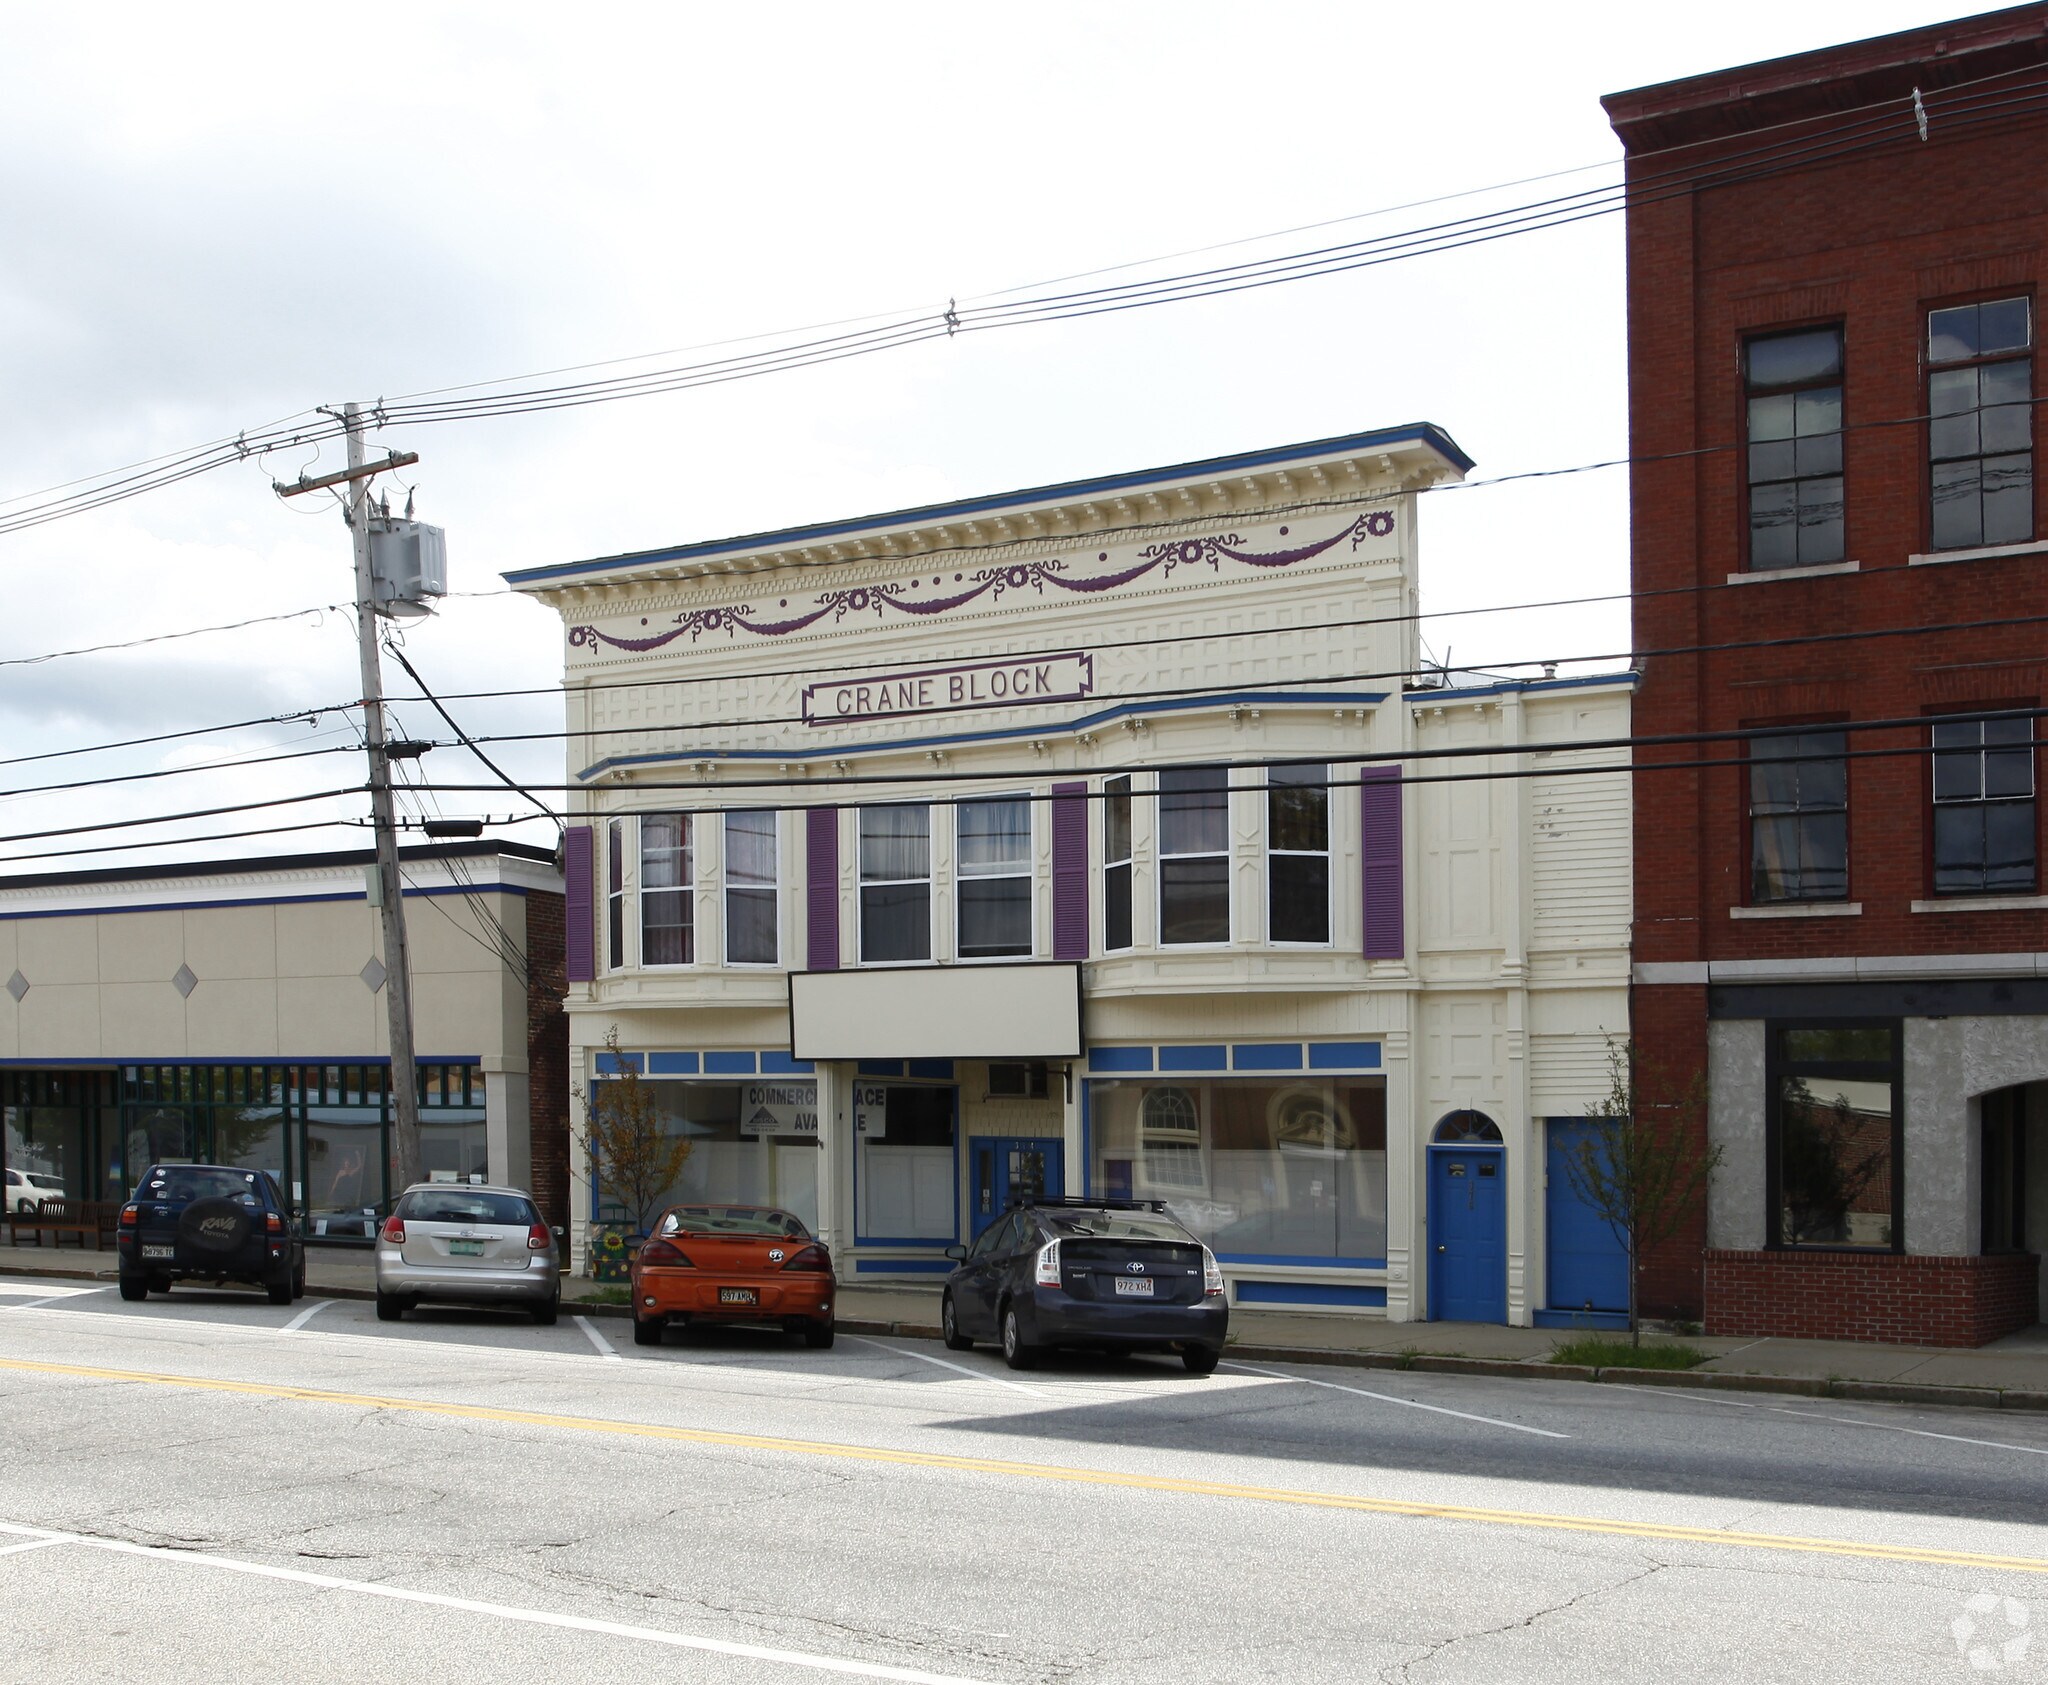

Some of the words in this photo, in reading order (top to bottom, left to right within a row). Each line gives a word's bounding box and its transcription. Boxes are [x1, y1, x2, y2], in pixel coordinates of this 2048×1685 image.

[836, 679, 934, 714] CRANE
[949, 665, 1052, 702] BLOCK
[749, 1087, 818, 1105] COMMERCI
[855, 1088, 885, 1106] ACE
[203, 1229, 229, 1239] TOYOTA
[1117, 1281, 1134, 1291] 972
[1136, 1282, 1151, 1292] XH4
